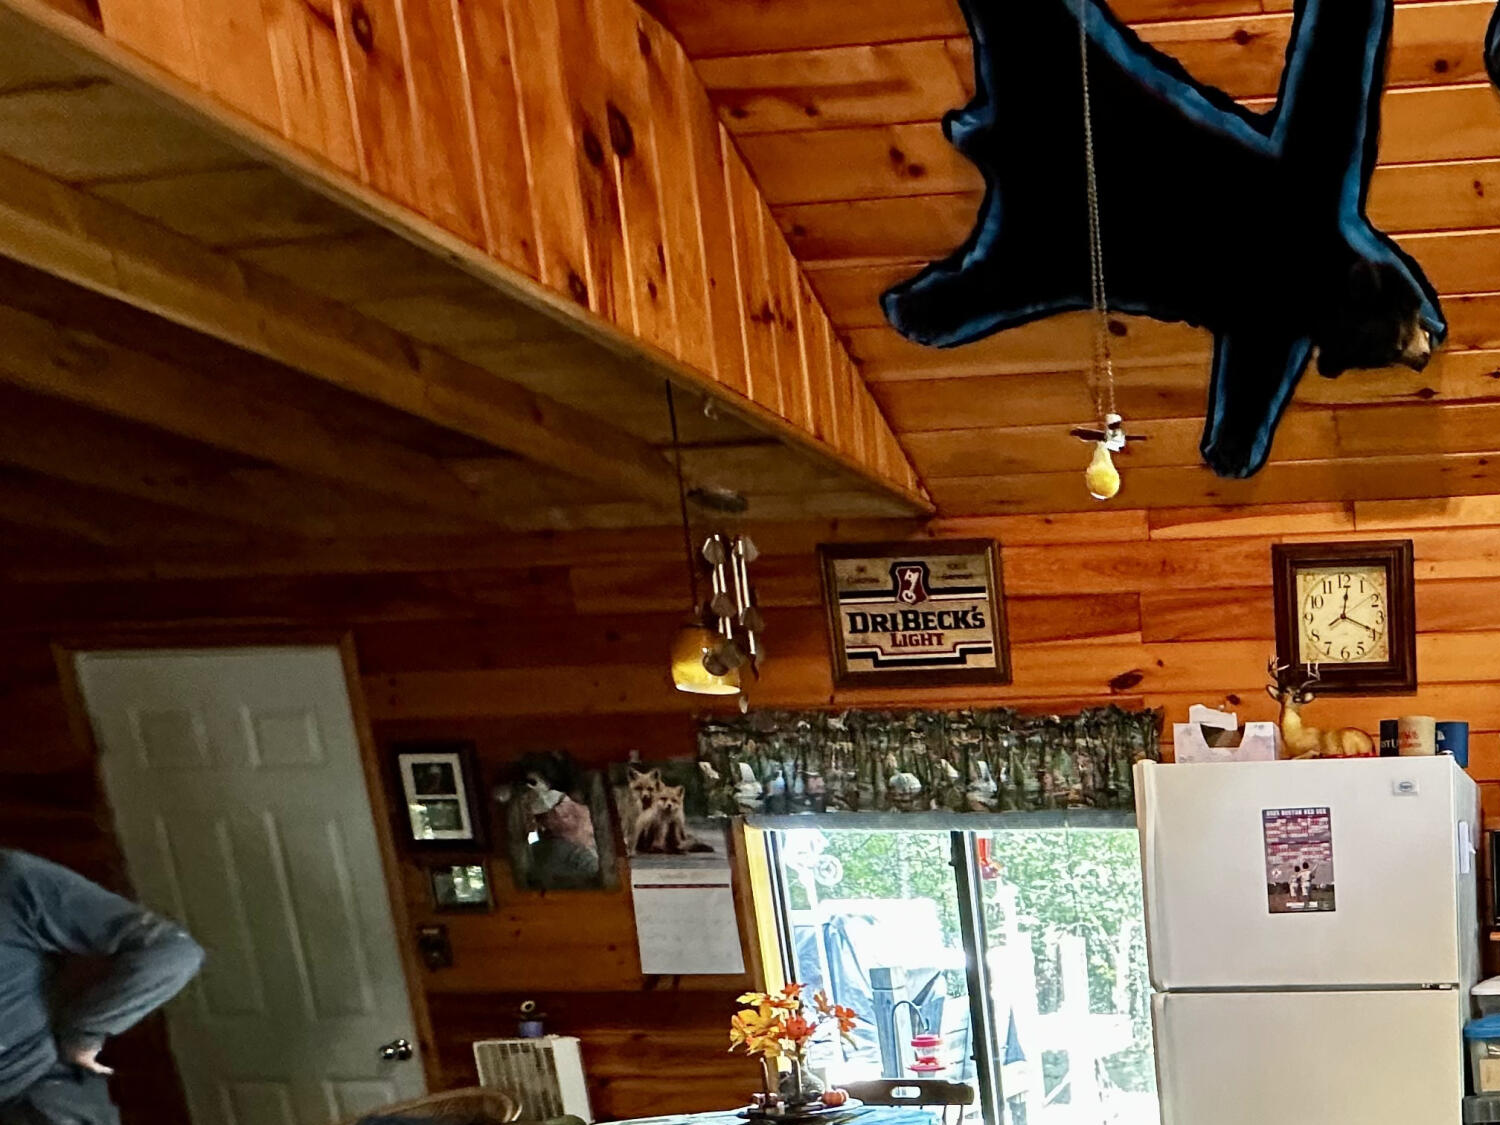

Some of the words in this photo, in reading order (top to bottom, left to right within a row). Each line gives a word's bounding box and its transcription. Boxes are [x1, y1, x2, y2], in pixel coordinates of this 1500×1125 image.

[1322, 580, 1333, 594] 11
[1337, 574, 1351, 589] 12
[1360, 580, 1365, 593] 1
[1310, 595, 1324, 609] 10
[1370, 593, 1379, 607] 2
[1304, 612, 1314, 625] 9
[1375, 610, 1385, 625] 3
[890, 632, 945, 648] LIGHT
[1311, 628, 1320, 642] 8
[1368, 627, 1377, 641] 4
[1324, 641, 1333, 656] 7
[1341, 646, 1350, 660] 6
[1356, 641, 1365, 655] 5
